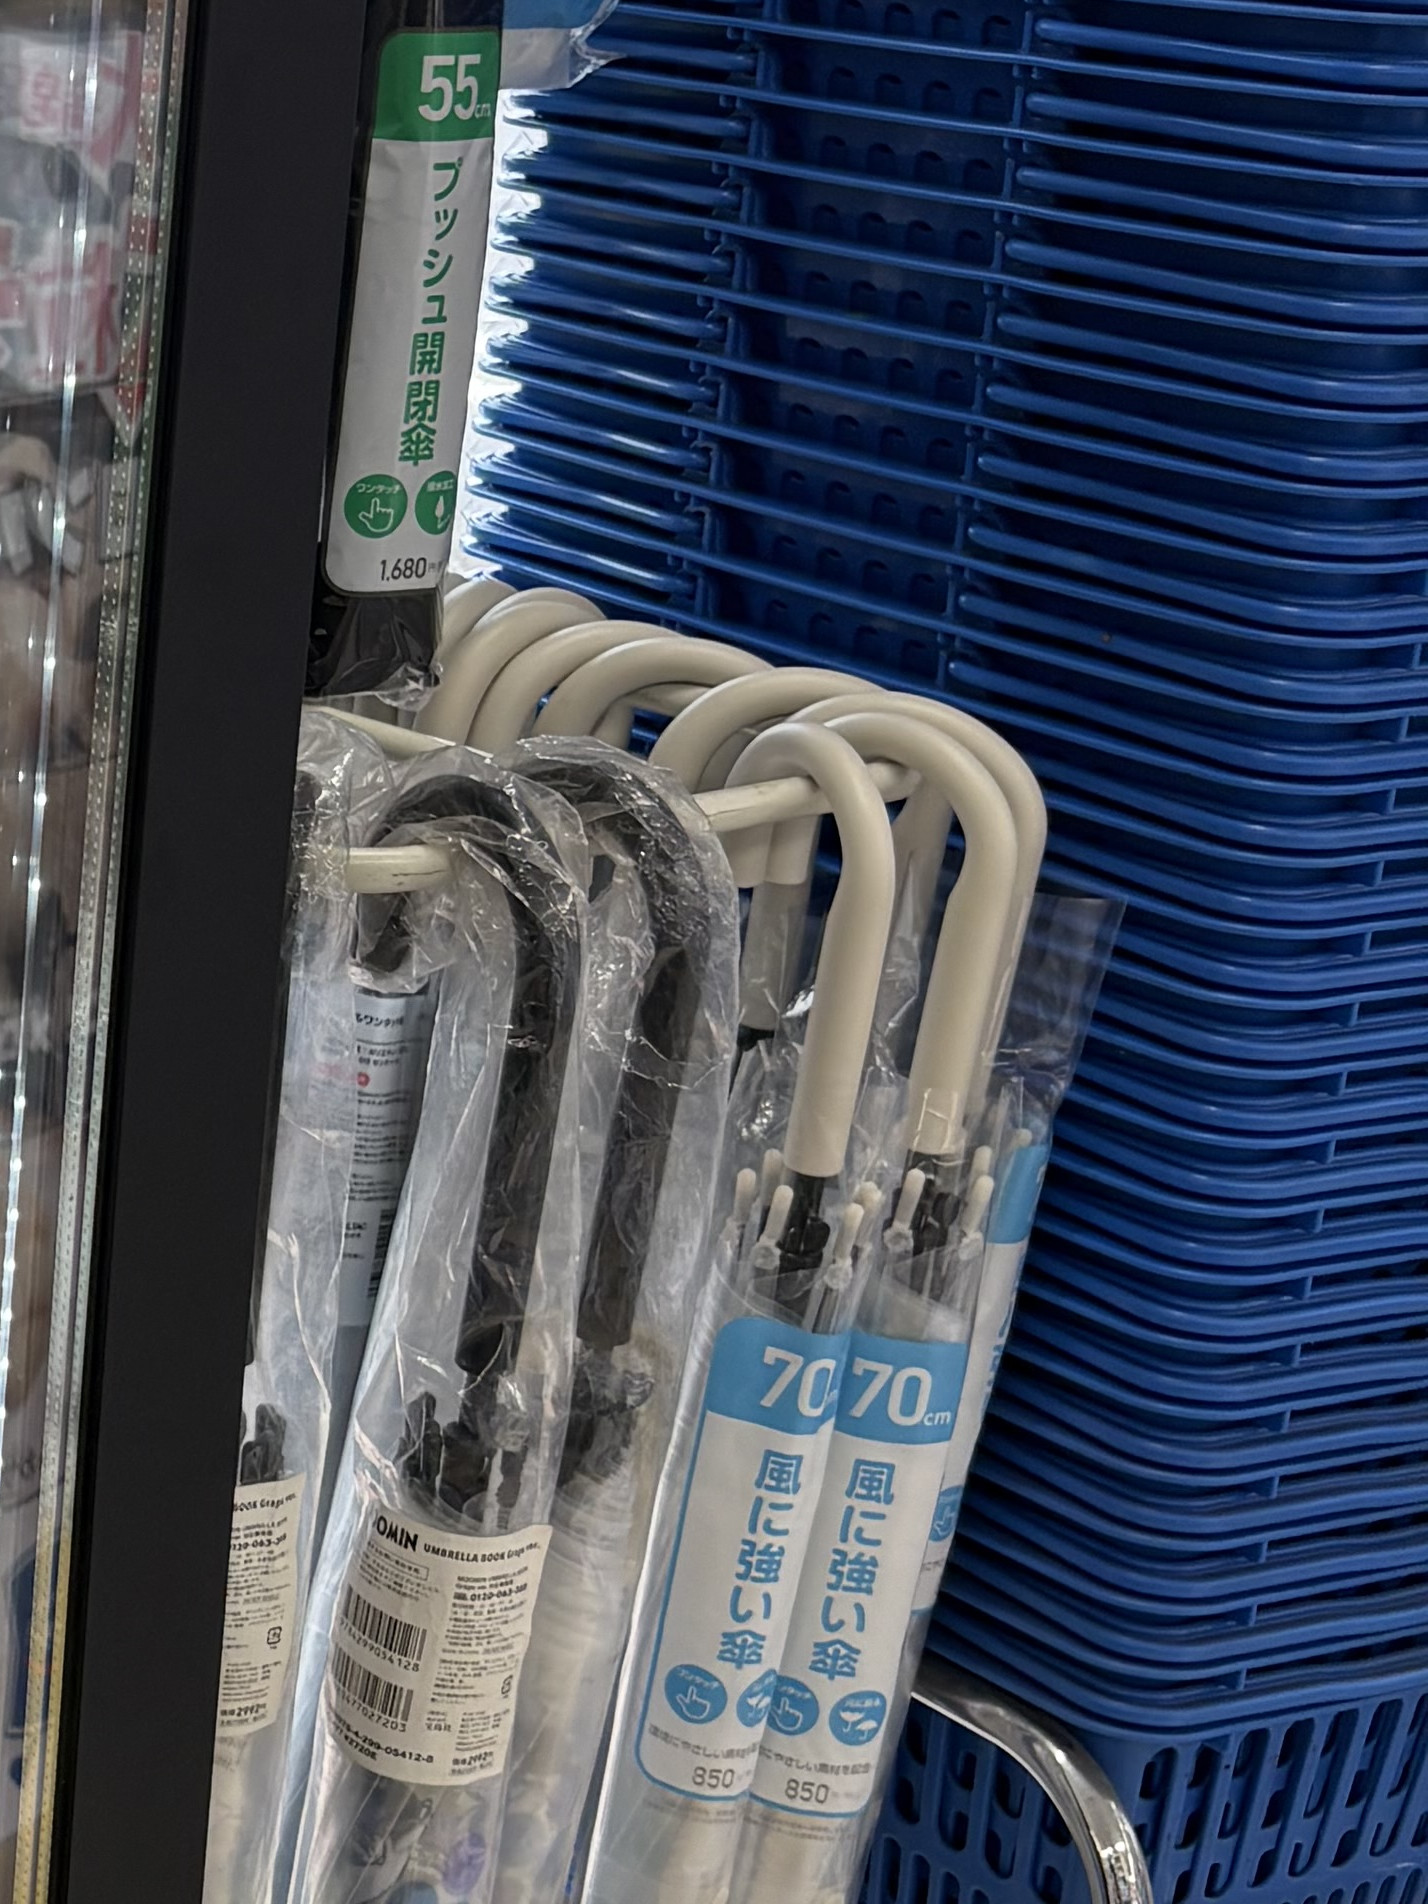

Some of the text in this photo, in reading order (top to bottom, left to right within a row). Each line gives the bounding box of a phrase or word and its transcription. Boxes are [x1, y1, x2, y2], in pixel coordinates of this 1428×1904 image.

[398, 157, 464, 466] プッシュ開閉傘
[716, 1448, 803, 1671] 風に強い傘
[808, 1457, 896, 1683] 風に強い傘
[691, 1765, 735, 1790] 850
[784, 1778, 830, 1804] 850
